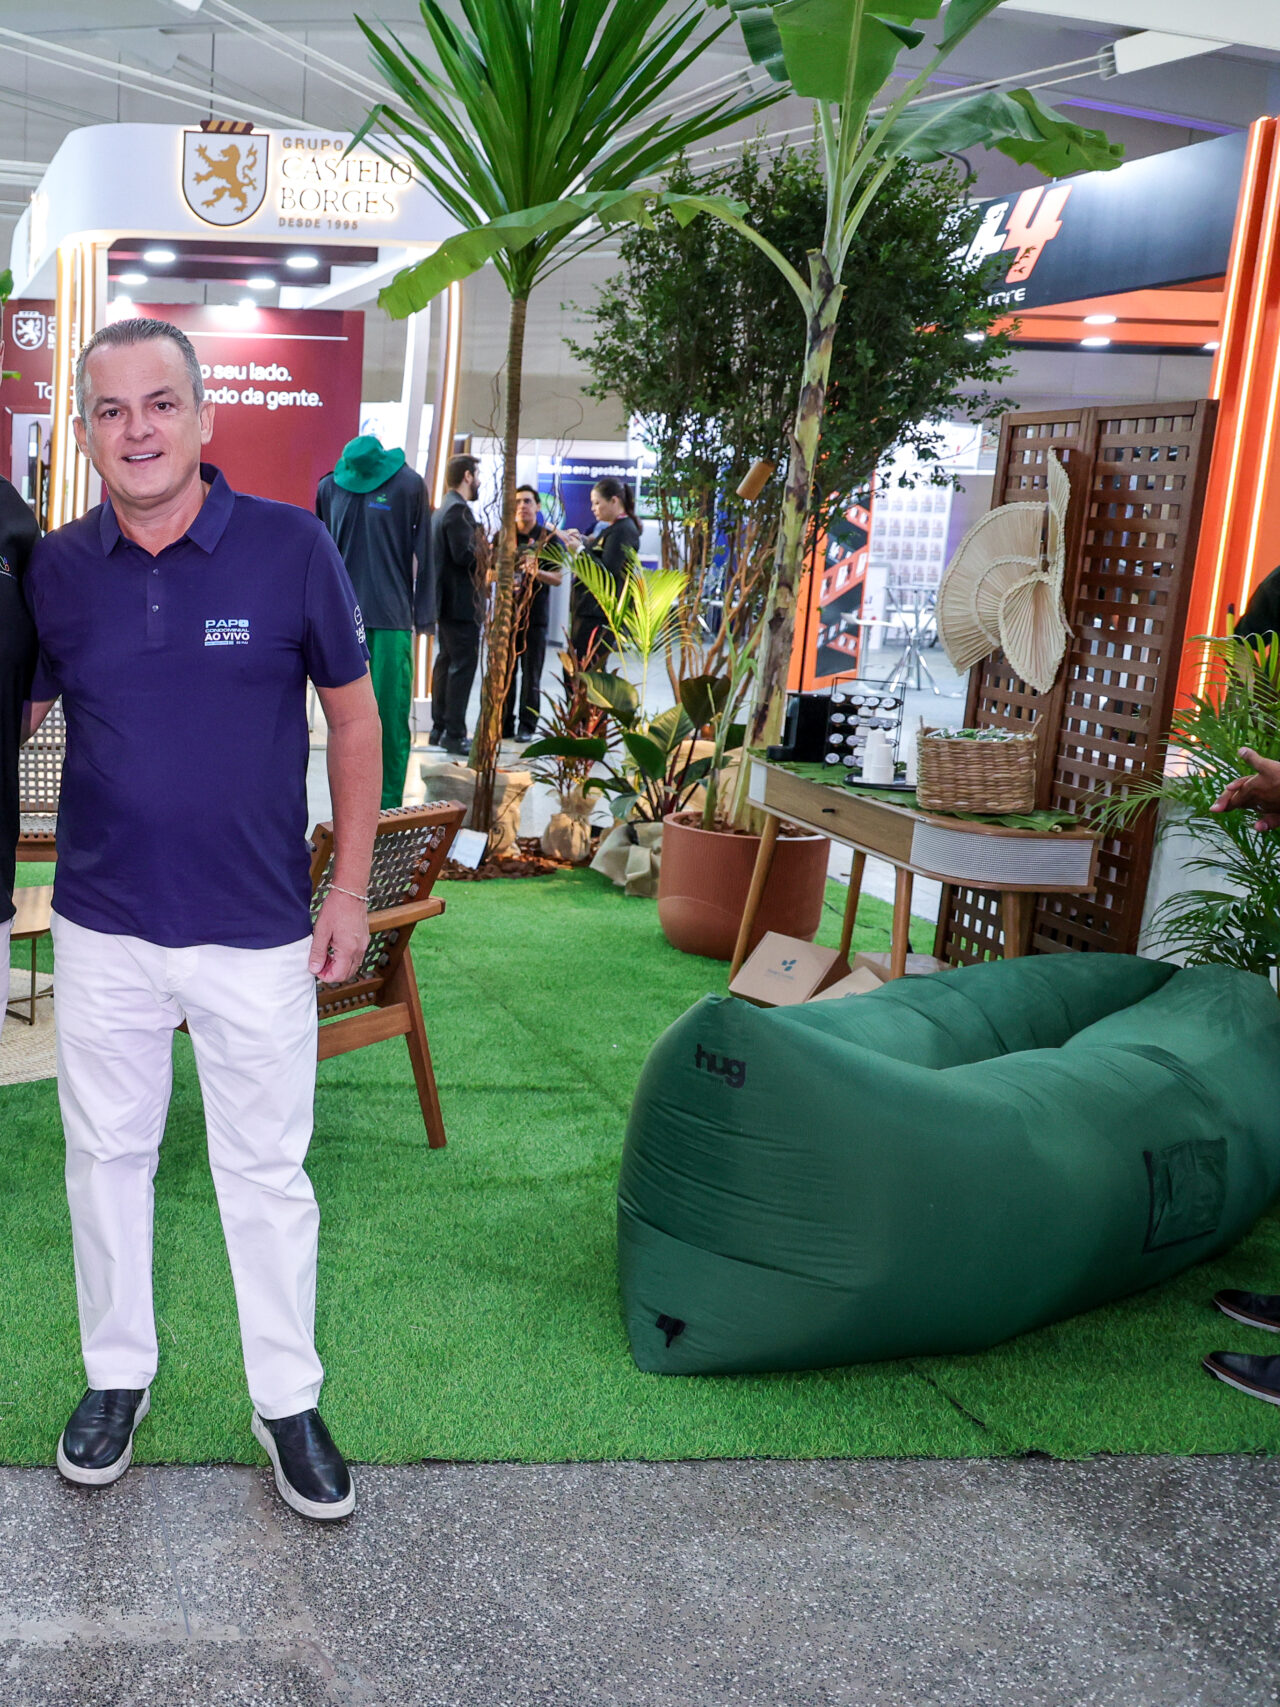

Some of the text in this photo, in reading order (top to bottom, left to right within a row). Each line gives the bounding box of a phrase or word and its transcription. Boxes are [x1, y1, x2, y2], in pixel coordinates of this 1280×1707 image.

[282, 136, 344, 151] GRUPO
[281, 156, 413, 185] CASTELO
[280, 187, 395, 214] BORGES
[278, 217, 358, 230] DESDE 1995
[213, 364, 247, 380] seu
[249, 361, 293, 381] lado.
[240, 387, 265, 405] da
[266, 389, 324, 411] gente.
[204, 632, 251, 641] AO VIVO
[693, 1043, 747, 1089] hug
